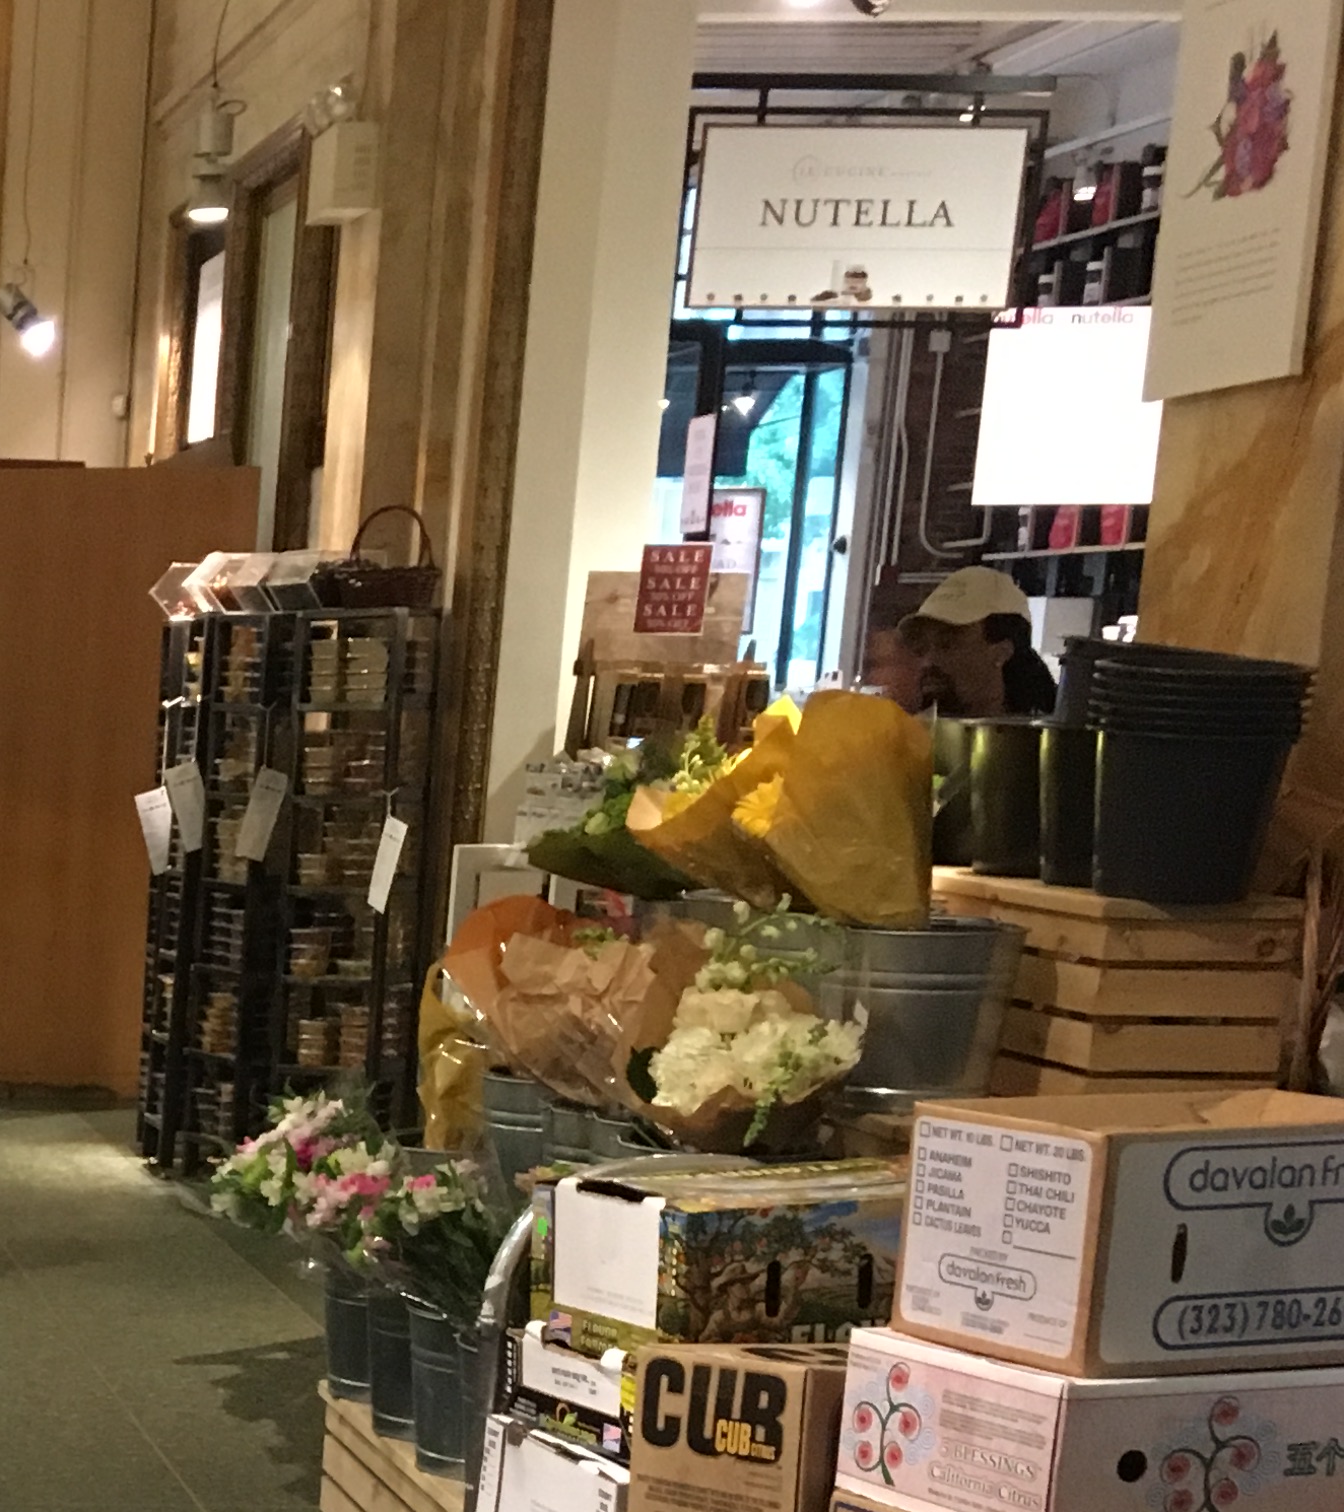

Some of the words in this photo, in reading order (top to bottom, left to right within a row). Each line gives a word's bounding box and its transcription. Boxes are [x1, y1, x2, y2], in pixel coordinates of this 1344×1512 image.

[759, 198, 955, 228] NUTELLA
[1071, 304, 1134, 324] nutella
[711, 500, 748, 517] ella
[650, 549, 705, 562] SALE
[646, 577, 701, 590] SALE
[643, 604, 698, 617] SALE
[929, 1151, 973, 1168] ANAHEIM
[1020, 1166, 1072, 1185] SHISHITO
[1189, 1155, 1316, 1193] davalan
[927, 1184, 965, 1200] PASILLA
[1018, 1183, 1043, 1199] THAI
[1045, 1187, 1075, 1204] CHILI
[926, 1199, 972, 1218] PLANTAIN
[1016, 1200, 1067, 1220] CHAYOTE
[1015, 1217, 1051, 1235] YUCCA
[1178, 1301, 1250, 1341] (323)
[1255, 1296, 1344, 1331] 780-26
[641, 1355, 788, 1465] CUB
[714, 1418, 752, 1457] CUB
[954, 1444, 1036, 1481] BLESSINGS
[929, 1463, 995, 1495] California
[998, 1483, 1041, 1509] Citrus
